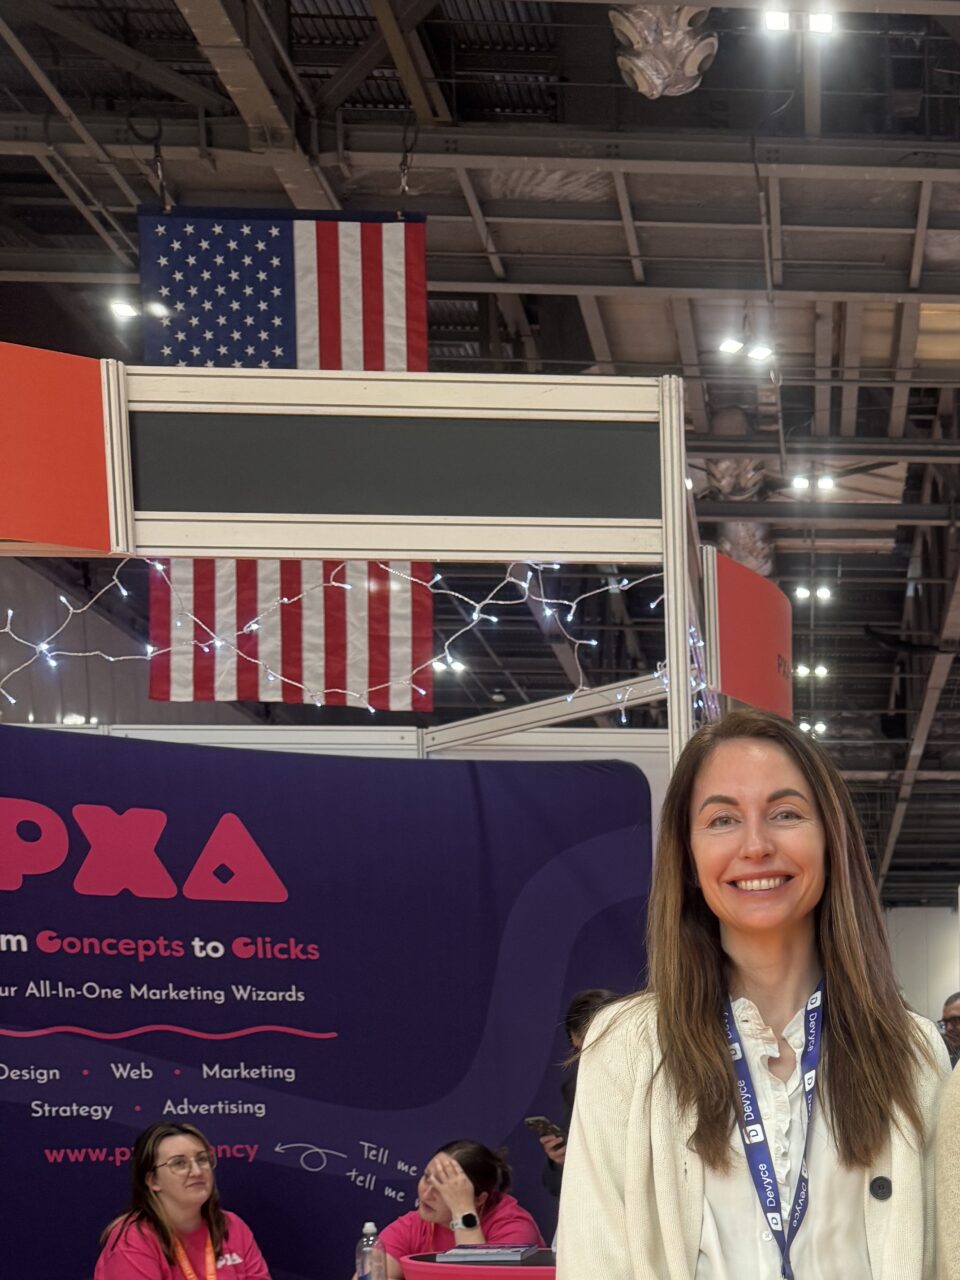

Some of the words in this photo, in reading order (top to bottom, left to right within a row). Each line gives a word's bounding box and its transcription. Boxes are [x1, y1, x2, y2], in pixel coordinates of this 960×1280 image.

[0, 797, 288, 903] PXA
[36, 930, 184, 962] Concepts
[191, 937, 225, 958] to
[232, 936, 320, 960] Clicks
[0, 986, 18, 996] ur
[25, 980, 123, 999] All-In-One
[130, 983, 225, 1004] Marketing
[231, 984, 305, 1002] Wizards
[110, 1063, 153, 1080] Web
[202, 1063, 296, 1082] Marketing
[31, 1100, 113, 1120] Strategy
[163, 1098, 266, 1117] Advertising
[738, 1080, 755, 1120] Devyce
[44, 1143, 259, 1166] www.pncy
[359, 1141, 389, 1165] Tell
[396, 1160, 418, 1176] me
[345, 1168, 376, 1191] tell
[384, 1186, 405, 1202] me
[758, 1163, 776, 1207] Devyce
